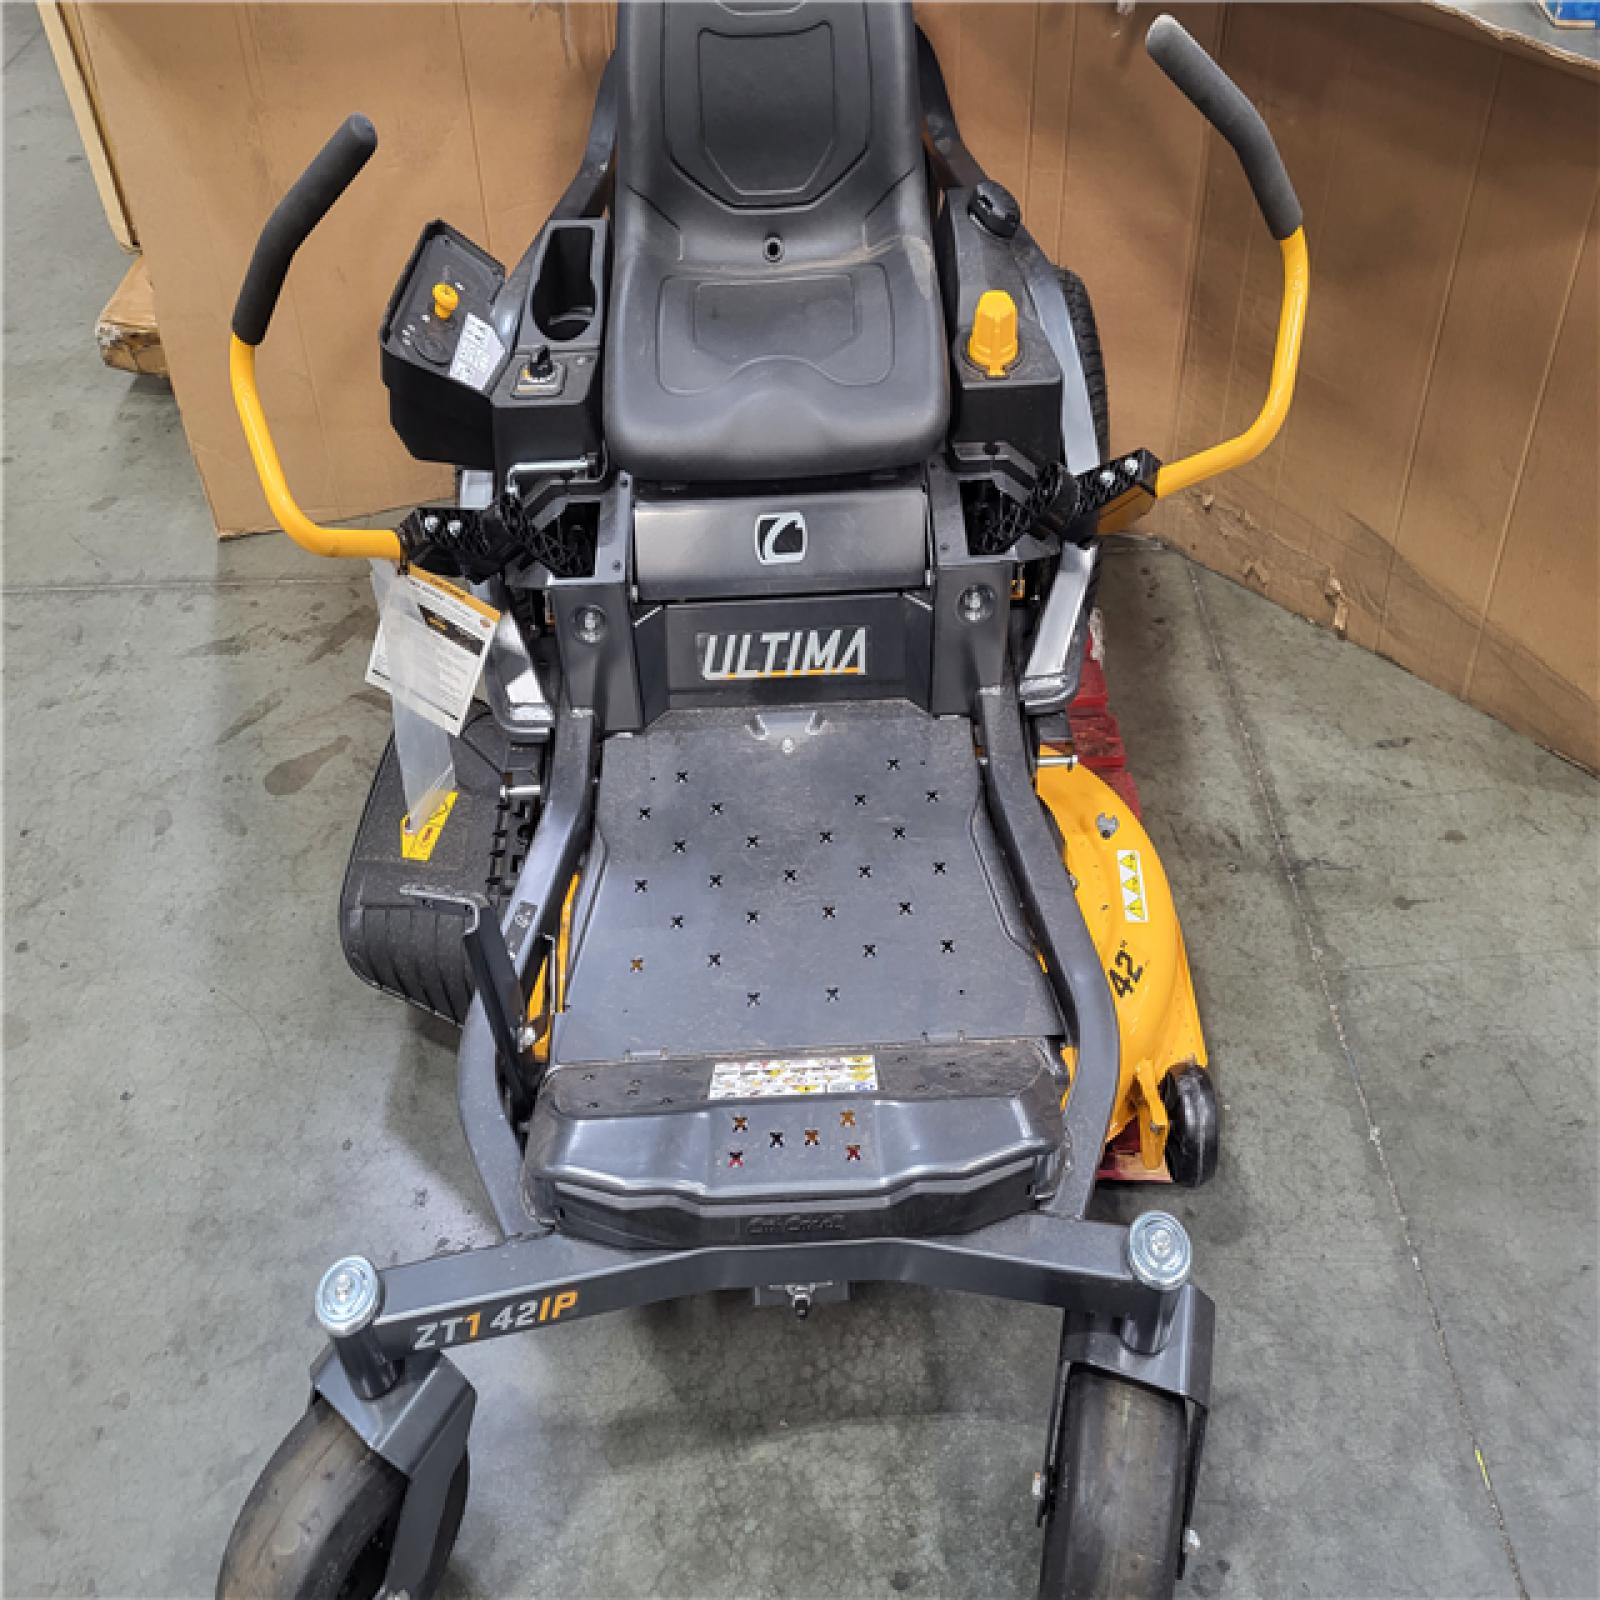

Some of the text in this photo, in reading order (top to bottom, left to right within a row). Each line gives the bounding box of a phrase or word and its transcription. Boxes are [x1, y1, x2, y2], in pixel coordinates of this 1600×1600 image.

[702, 627, 867, 680] ULTIMA
[414, 1290, 579, 1350] ZT1 42IP
